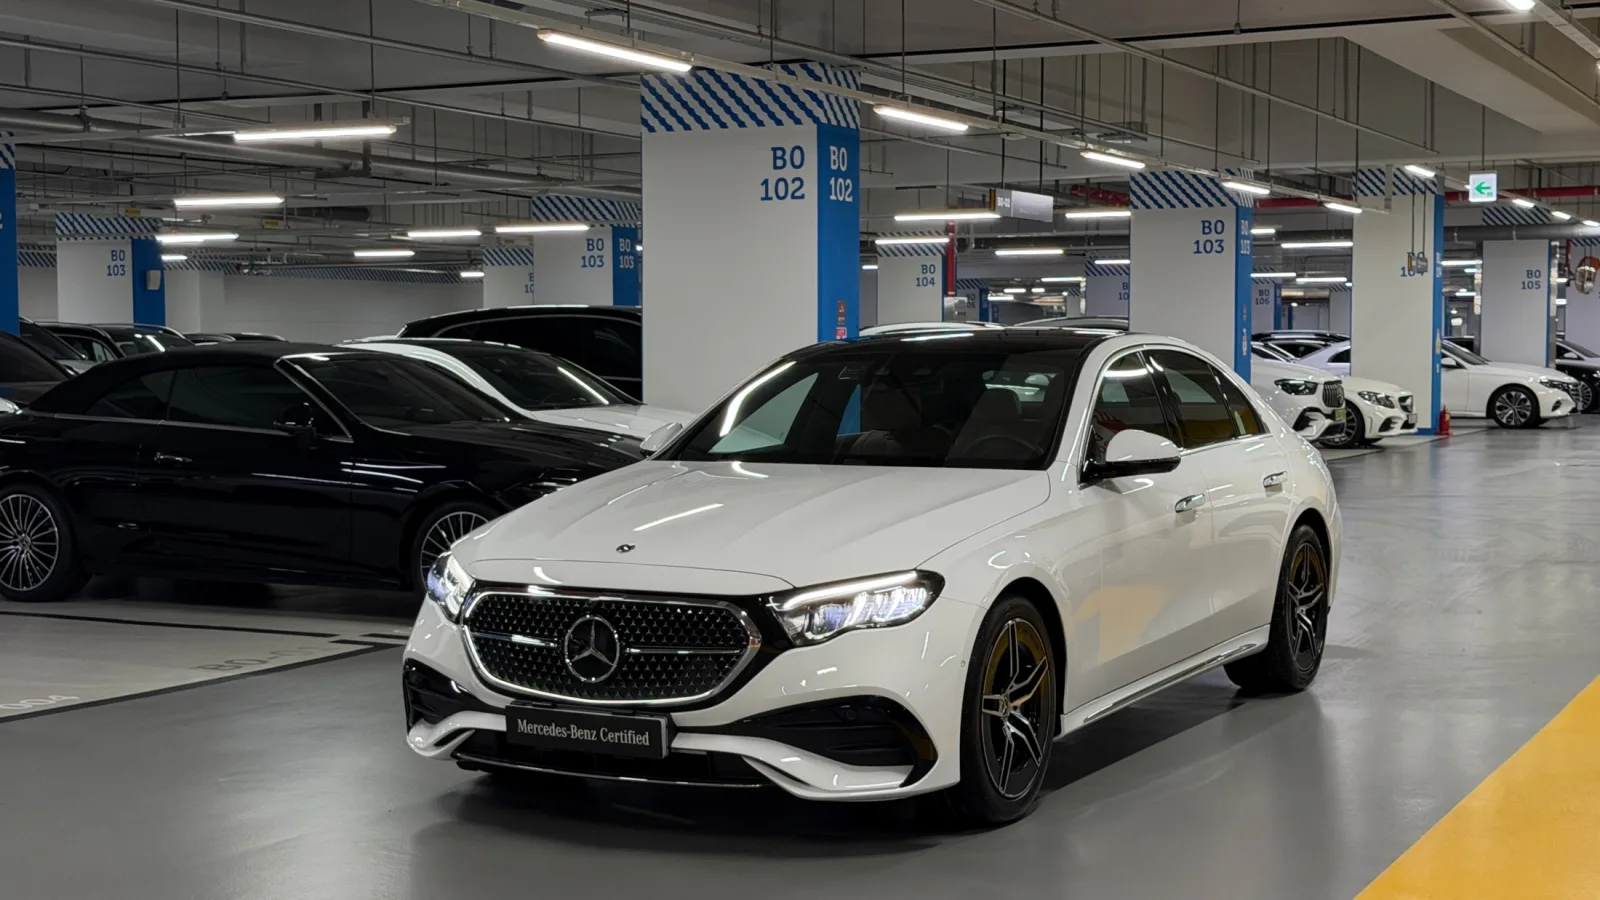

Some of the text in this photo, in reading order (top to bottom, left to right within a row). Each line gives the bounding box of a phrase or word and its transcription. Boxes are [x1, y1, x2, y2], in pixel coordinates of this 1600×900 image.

[760, 177, 805, 201] 102
[829, 177, 853, 202] 102
[1193, 239, 1225, 254] 103
[581, 255, 604, 268] 103
[619, 255, 634, 269] 103
[106, 264, 126, 276] 103
[916, 277, 936, 287] 104
[1521, 280, 1541, 290] 105
[1118, 292, 1129, 301] 10
[517, 718, 650, 746] Mercedes-Benz Certified
